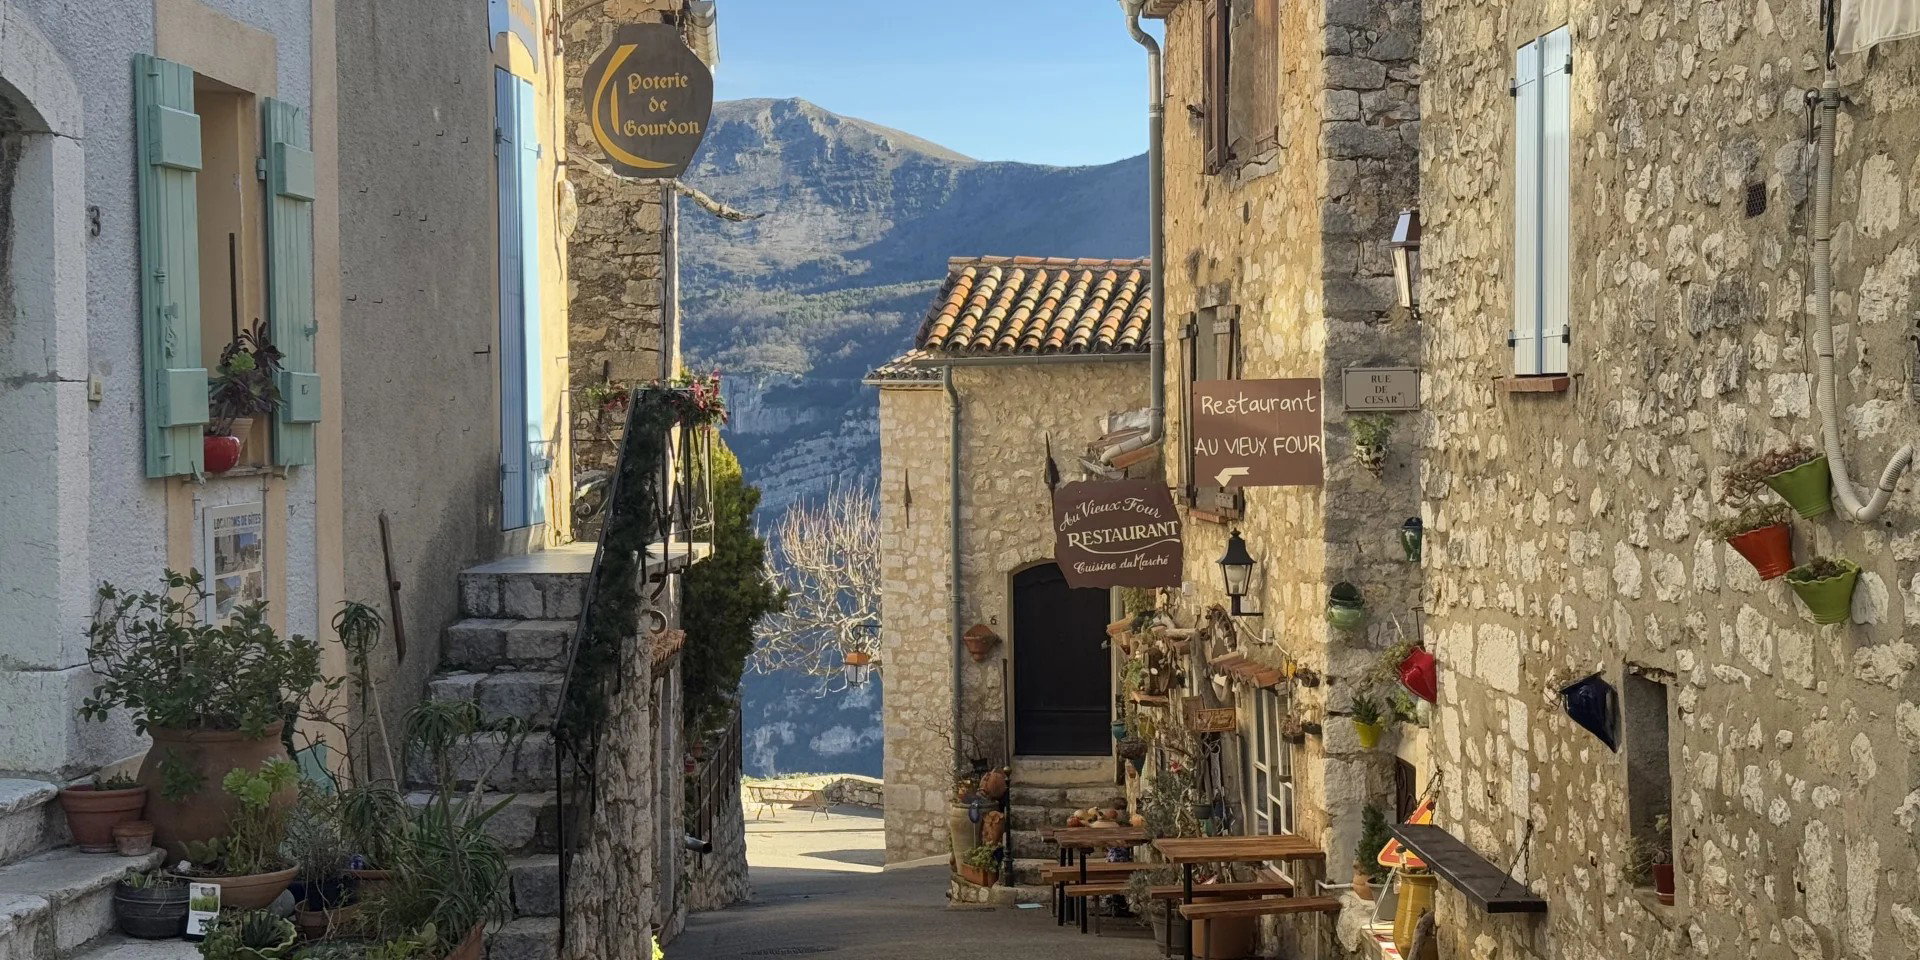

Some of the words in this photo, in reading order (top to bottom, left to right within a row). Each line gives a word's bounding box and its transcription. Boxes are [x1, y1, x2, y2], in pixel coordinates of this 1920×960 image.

[627, 72, 689, 95] Poterie
[648, 95, 668, 113] de
[623, 118, 701, 137] Gourdon
[90, 205, 101, 237] 3
[1371, 375, 1391, 383] RUE
[1364, 395, 1398, 404] CESAR
[1375, 386, 1388, 394] DE
[1201, 389, 1316, 416] Restaurant
[1194, 437, 1219, 456] AU
[1224, 436, 1267, 457] VIEUX
[1273, 435, 1320, 456] FOUR
[1060, 511, 1081, 531] Au
[1076, 499, 1121, 517] Vieux
[1122, 497, 1161, 518] Four
[1066, 520, 1179, 547] RESTAURANT
[1073, 561, 1116, 574] Cuisine
[1133, 553, 1169, 570] Marché
[990, 615, 998, 625] 6
